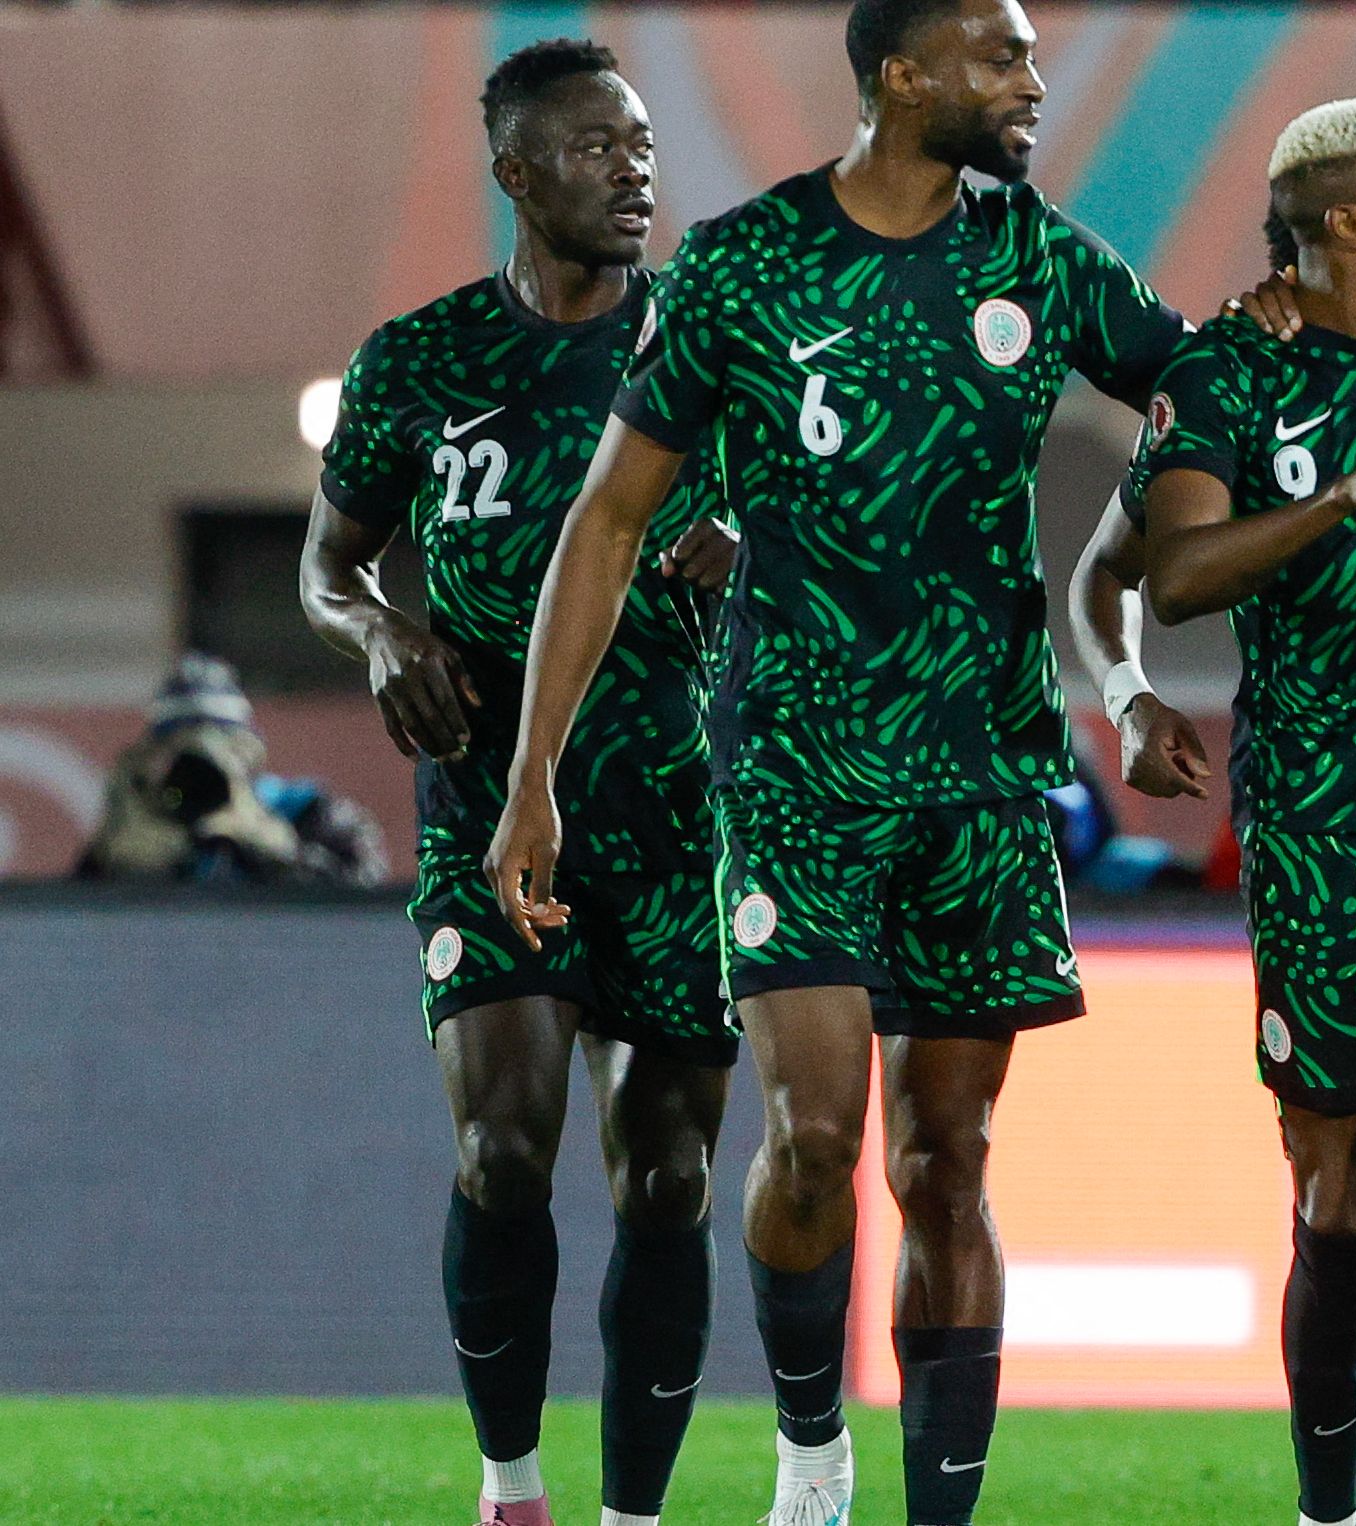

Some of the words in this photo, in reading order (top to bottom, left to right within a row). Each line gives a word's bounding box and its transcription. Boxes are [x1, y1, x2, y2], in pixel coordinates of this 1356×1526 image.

[799, 373, 842, 456] 6
[433, 439, 511, 522] 22
[1273, 445, 1317, 500] 9
